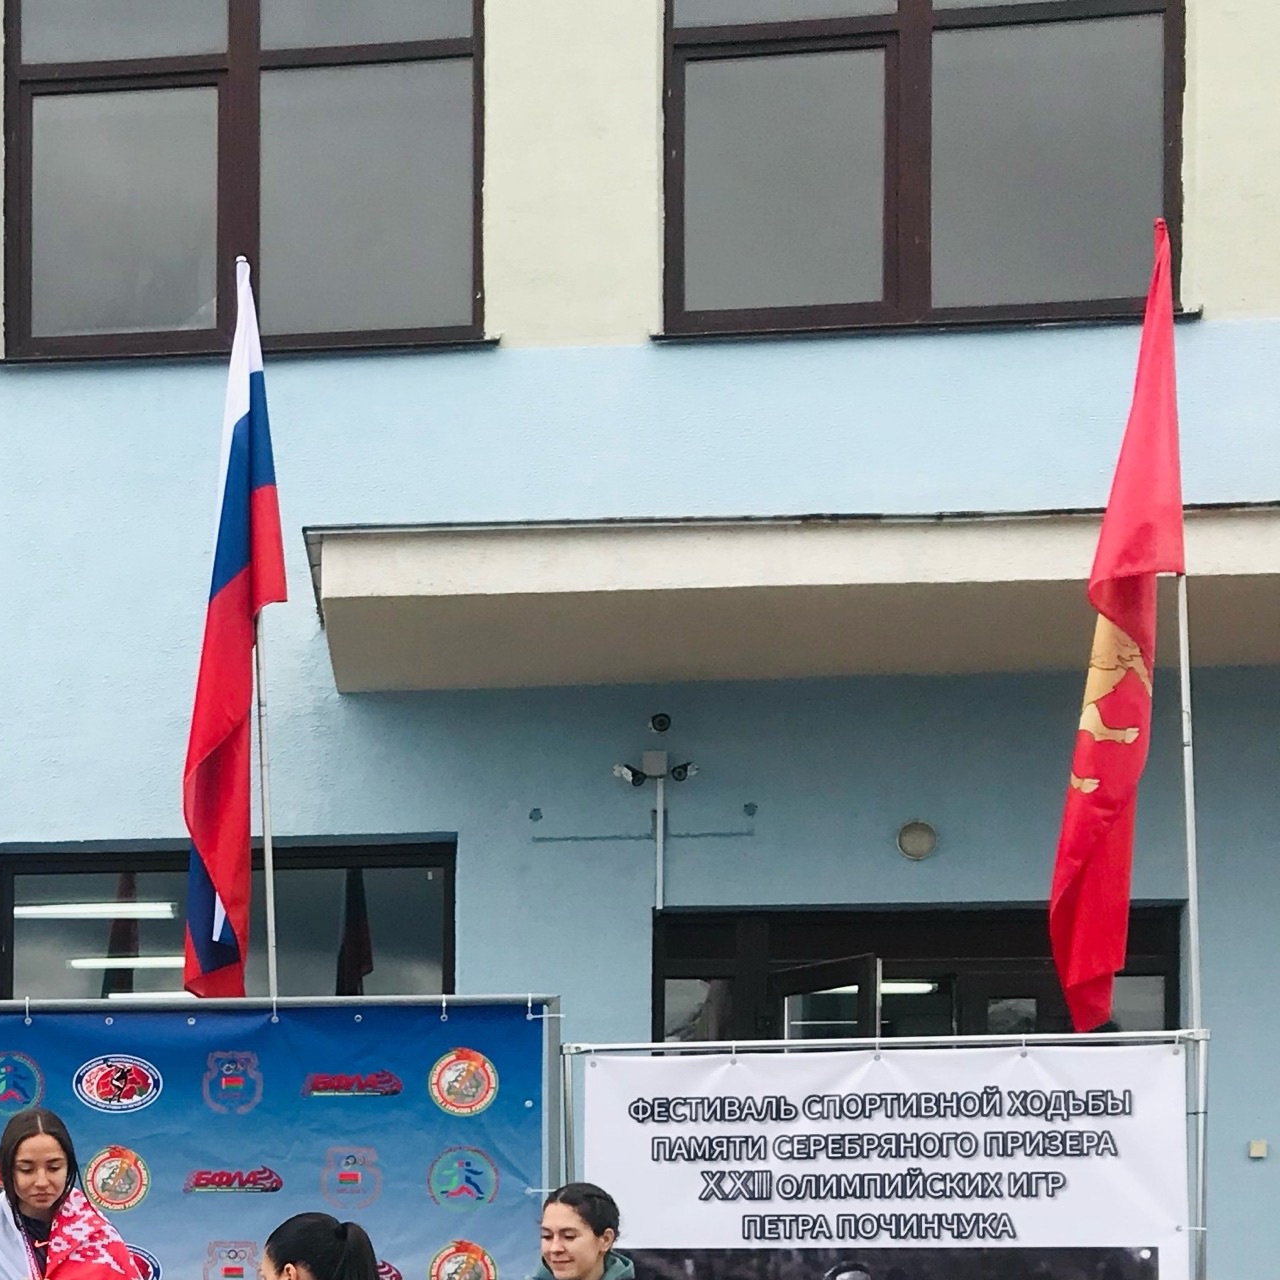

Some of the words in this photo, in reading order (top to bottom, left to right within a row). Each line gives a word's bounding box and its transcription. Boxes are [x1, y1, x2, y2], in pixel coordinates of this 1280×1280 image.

[628, 1096, 798, 1124] ФЕСТИВАЛЬ
[802, 1086, 1003, 1121] СПОРТИВНОЙ
[1007, 1090, 1132, 1122] ХОДЬБЫ
[651, 1136, 767, 1162] ПАМЯТИ
[772, 1131, 978, 1160] СЕРЕБРЯНОГО
[983, 1130, 1119, 1158] ПРИЗЕРА
[776, 1168, 1004, 1201] ОЛИМПИЙСКИХ
[1008, 1171, 1067, 1199] ИГР
[742, 1213, 833, 1240] ПЕТРА
[836, 1212, 1017, 1240] ПОЧИНЧУКА
